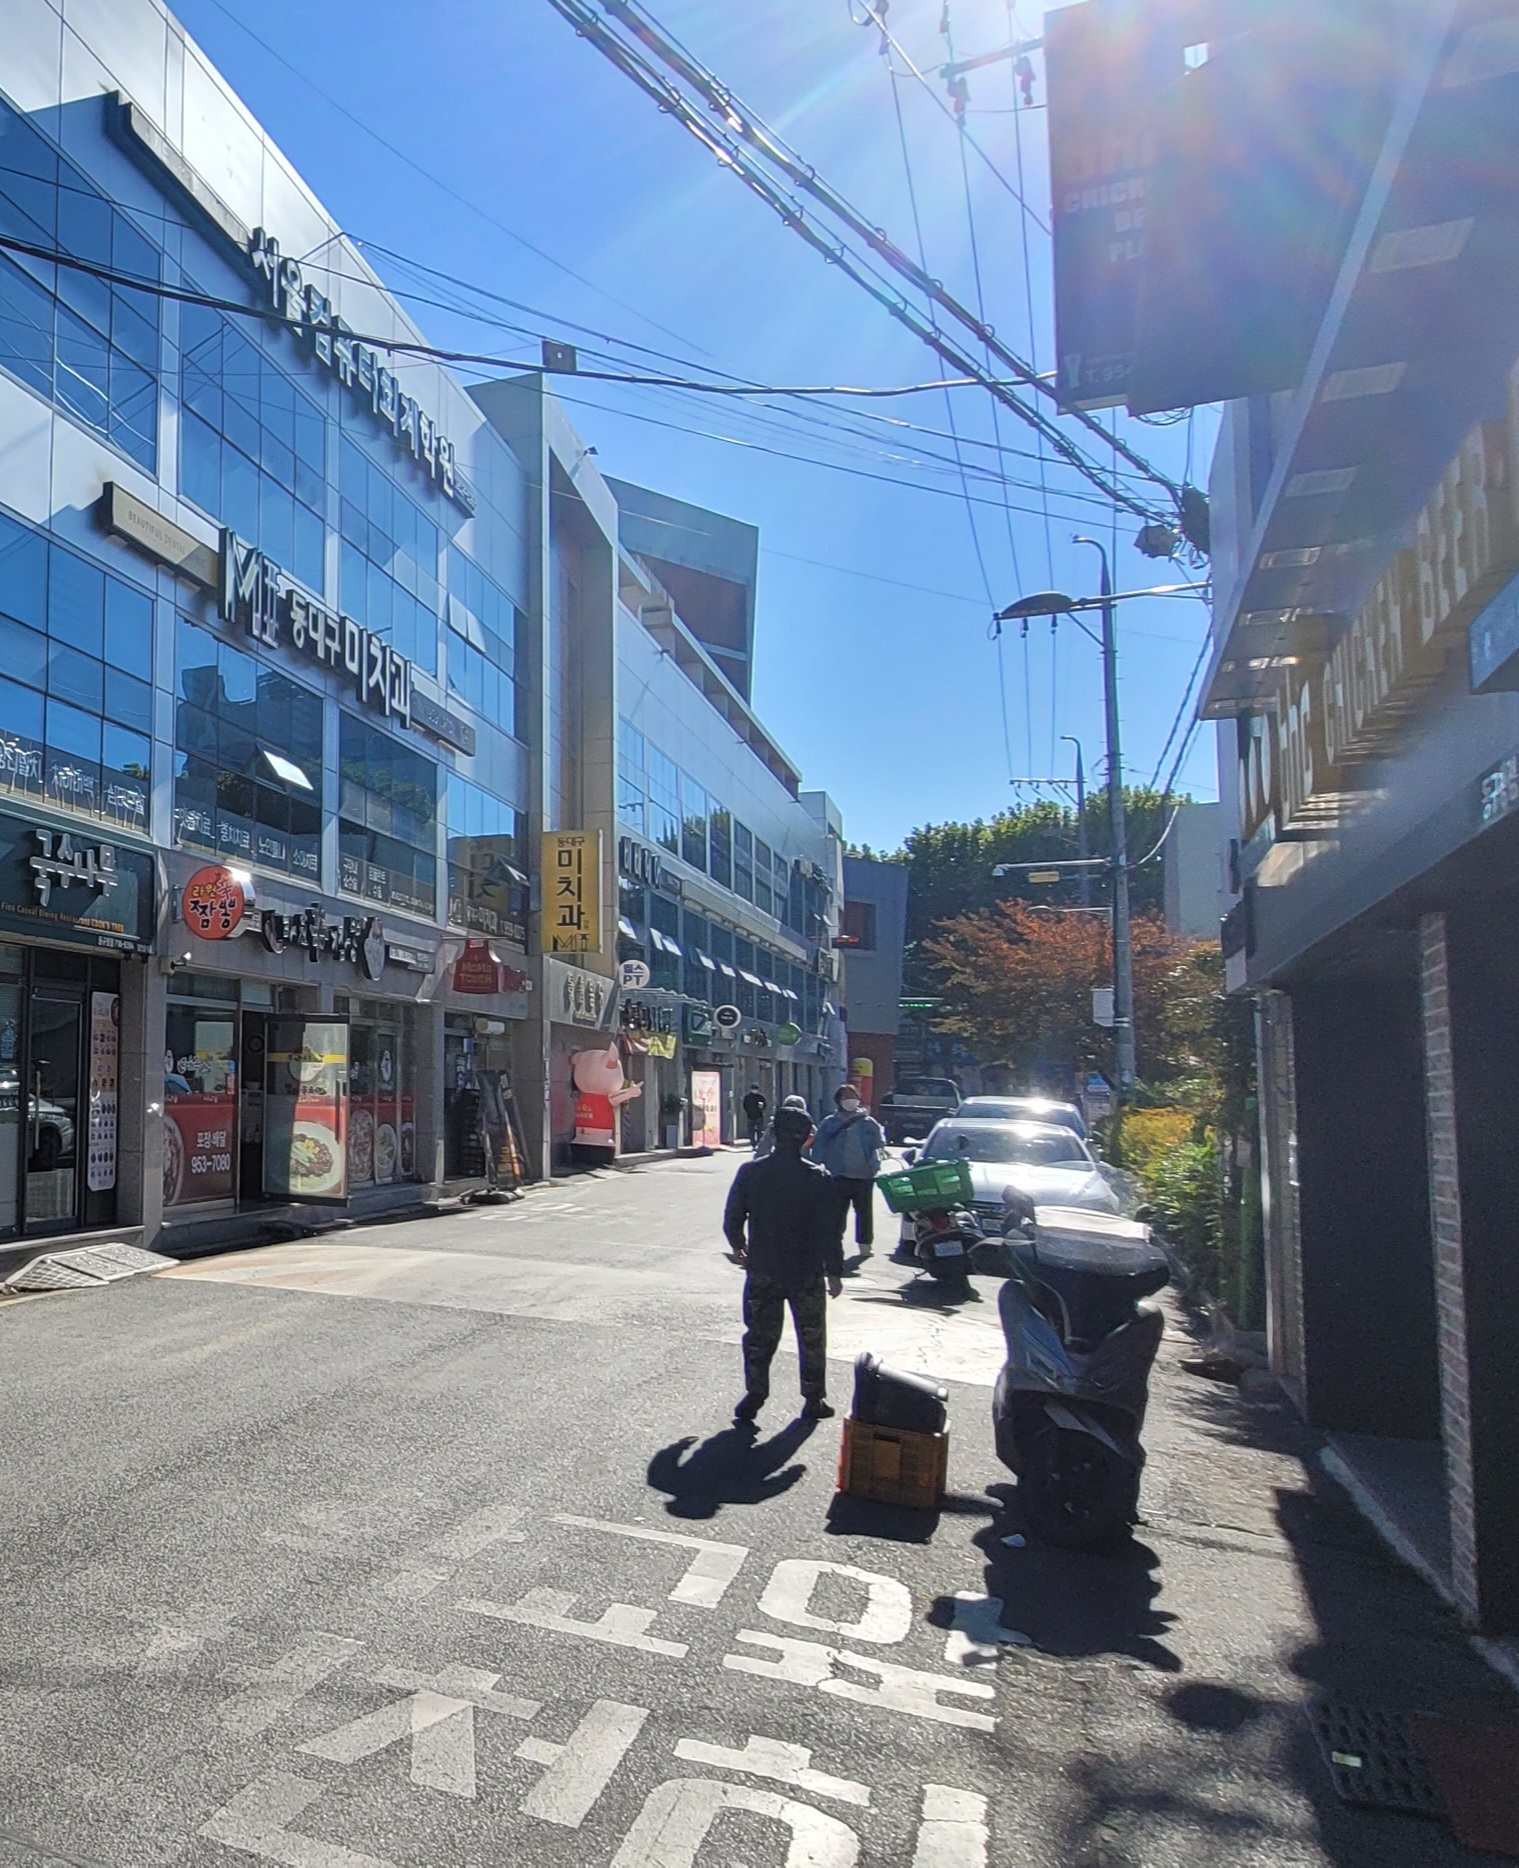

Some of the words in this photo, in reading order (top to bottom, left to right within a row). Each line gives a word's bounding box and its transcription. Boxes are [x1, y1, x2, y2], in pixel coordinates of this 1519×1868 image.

[1064, 174, 1146, 214] CHICK
[556, 836, 586, 848] 동대구
[30, 829, 118, 907] 국수나무
[556, 848, 586, 930] 미치과
[188, 896, 237, 931] 짬뽕
[623, 974, 644, 986] PT
